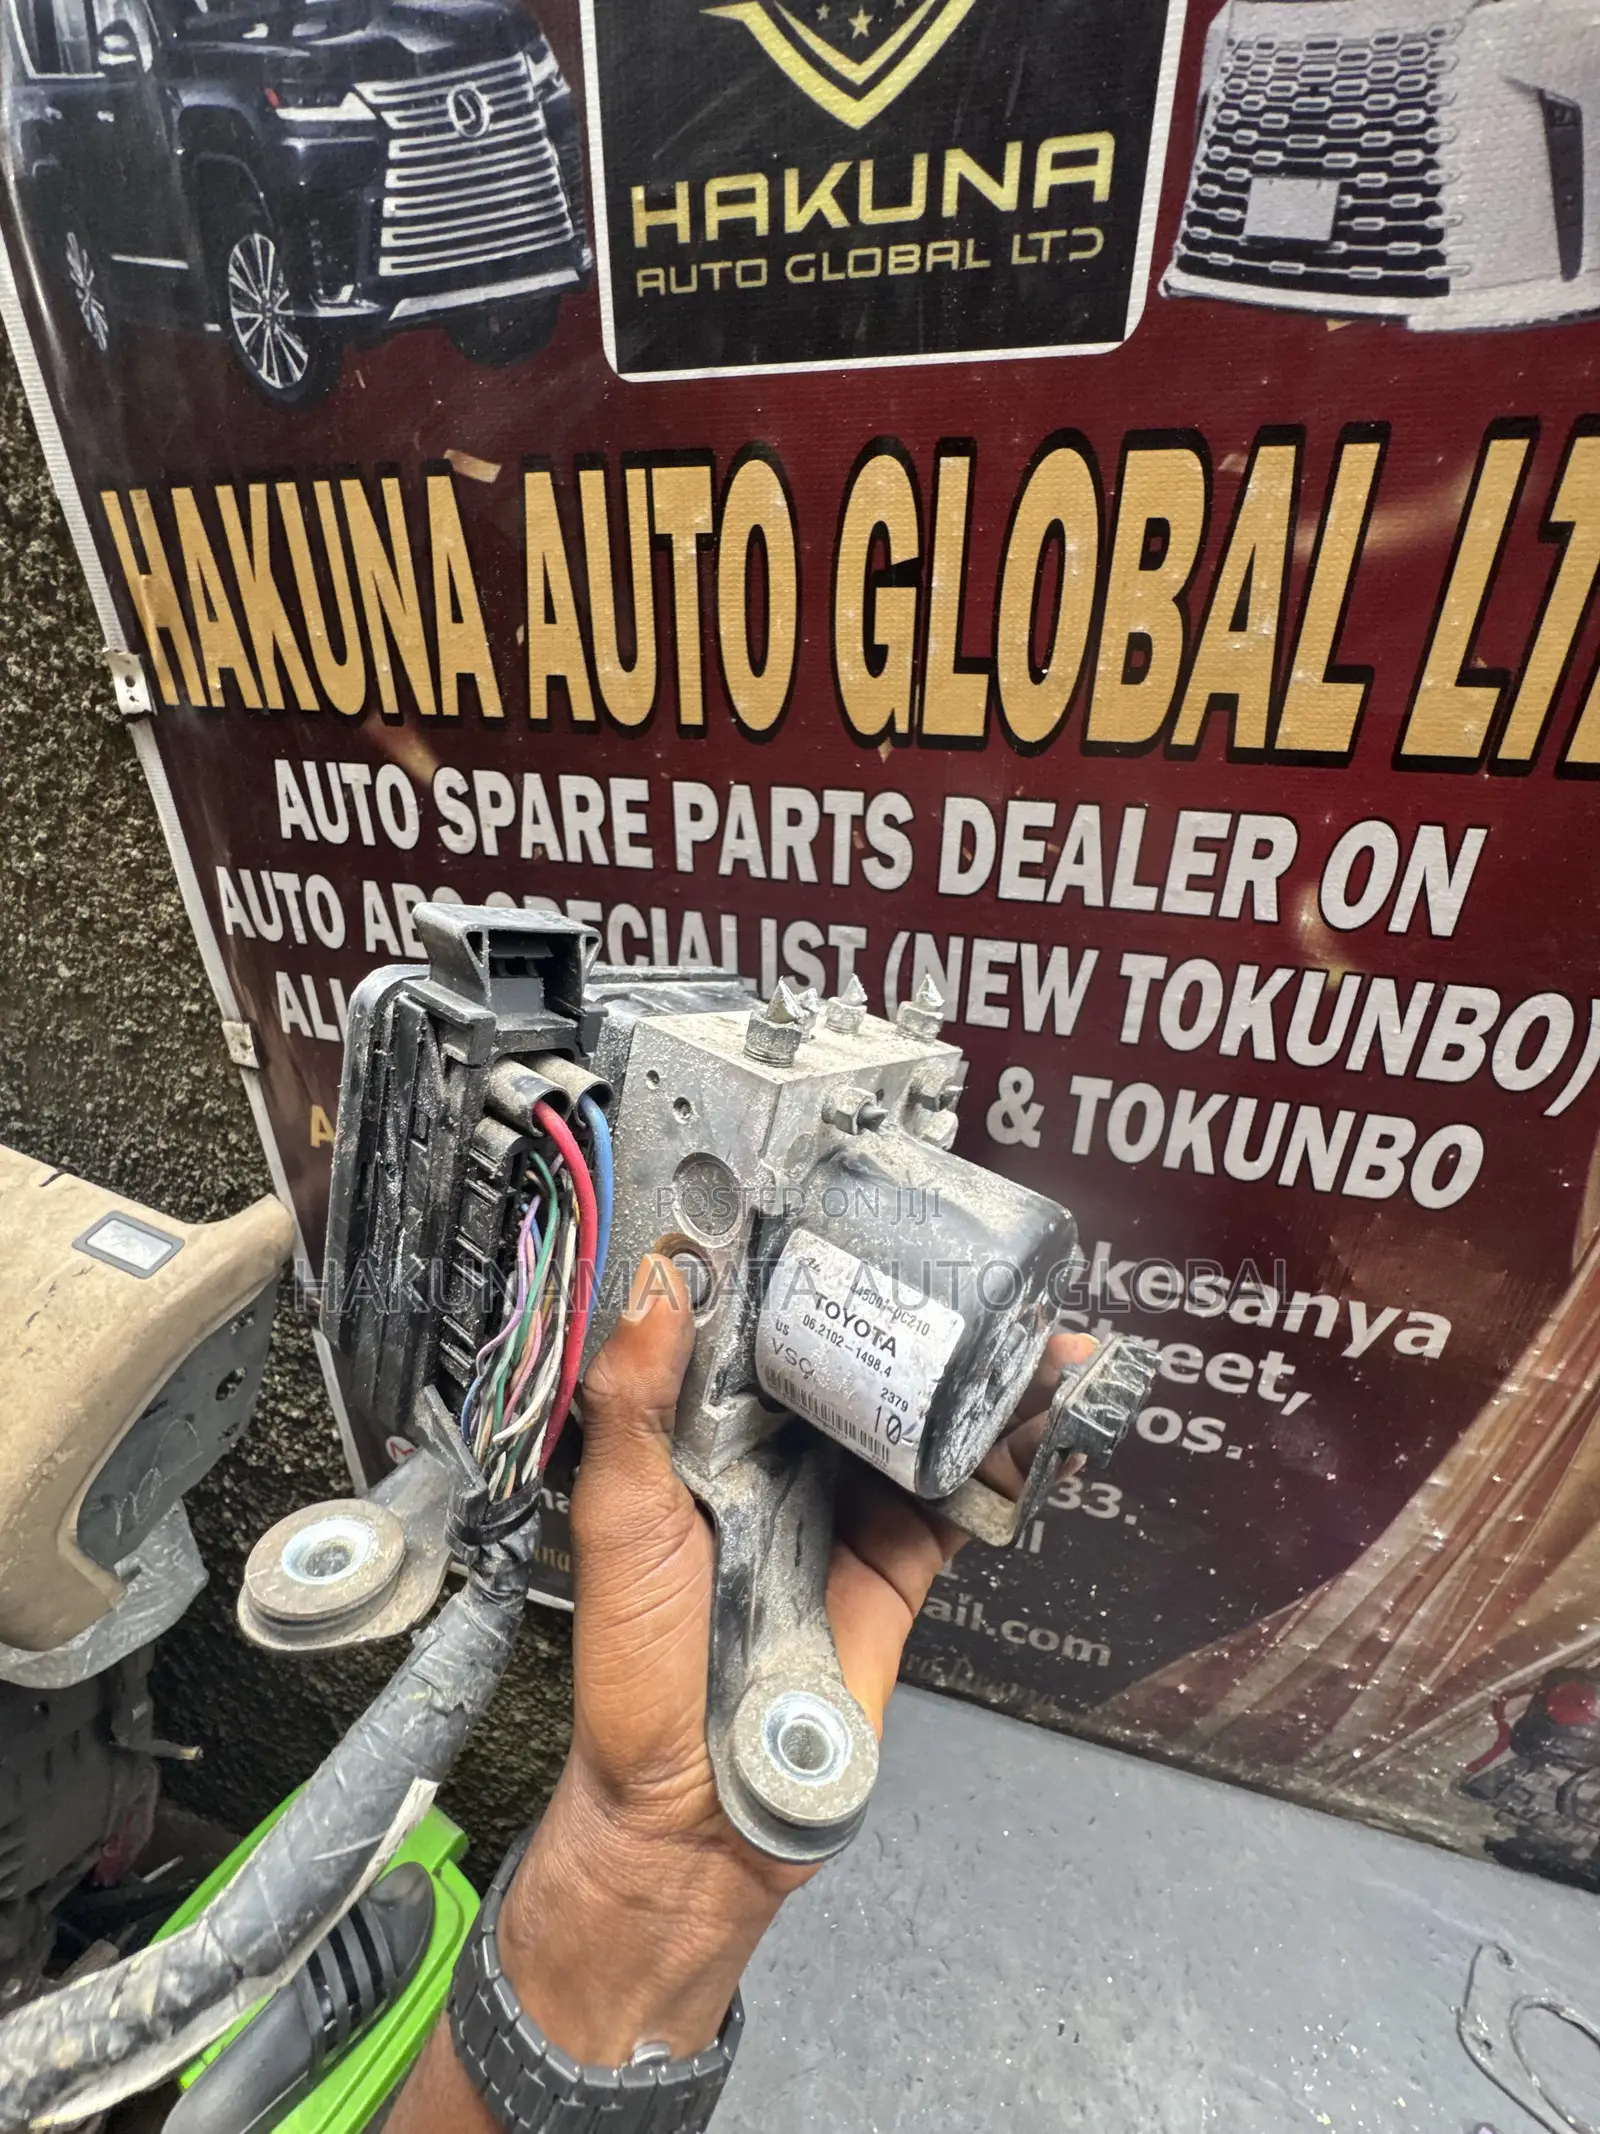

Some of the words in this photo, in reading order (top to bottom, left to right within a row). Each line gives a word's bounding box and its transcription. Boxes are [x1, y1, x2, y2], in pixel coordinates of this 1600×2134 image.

[631, 130, 1116, 248] HAKUNA
[636, 257, 768, 298] AUTO
[784, 237, 992, 285] GLOBAL
[1010, 226, 1105, 266] LTD
[101, 474, 505, 719] HAKUNA
[524, 457, 798, 733] AUTO
[832, 440, 1384, 754] GLOBAL
[1398, 434, 1600, 765] LT
[272, 758, 419, 851] AUTO
[431, 765, 654, 871] SPARE
[672, 780, 915, 891] PARTS
[938, 795, 1299, 923] DEALER
[1319, 818, 1488, 938] ON
[216, 865, 346, 950] AUTO
[362, 880, 464, 959] AB
[883, 930, 1100, 1038] (NEW
[1117, 952, 1600, 1117] TOKUNBO)
[986, 1065, 1046, 1149] &
[1069, 1074, 1485, 1210] TOKUNBO
[775, 1318, 790, 1336] US
[802, 1314, 893, 1378] 06.2102-1498.4
[815, 1291, 897, 1358] TOYOTA
[880, 1386, 909, 1413] 2379
